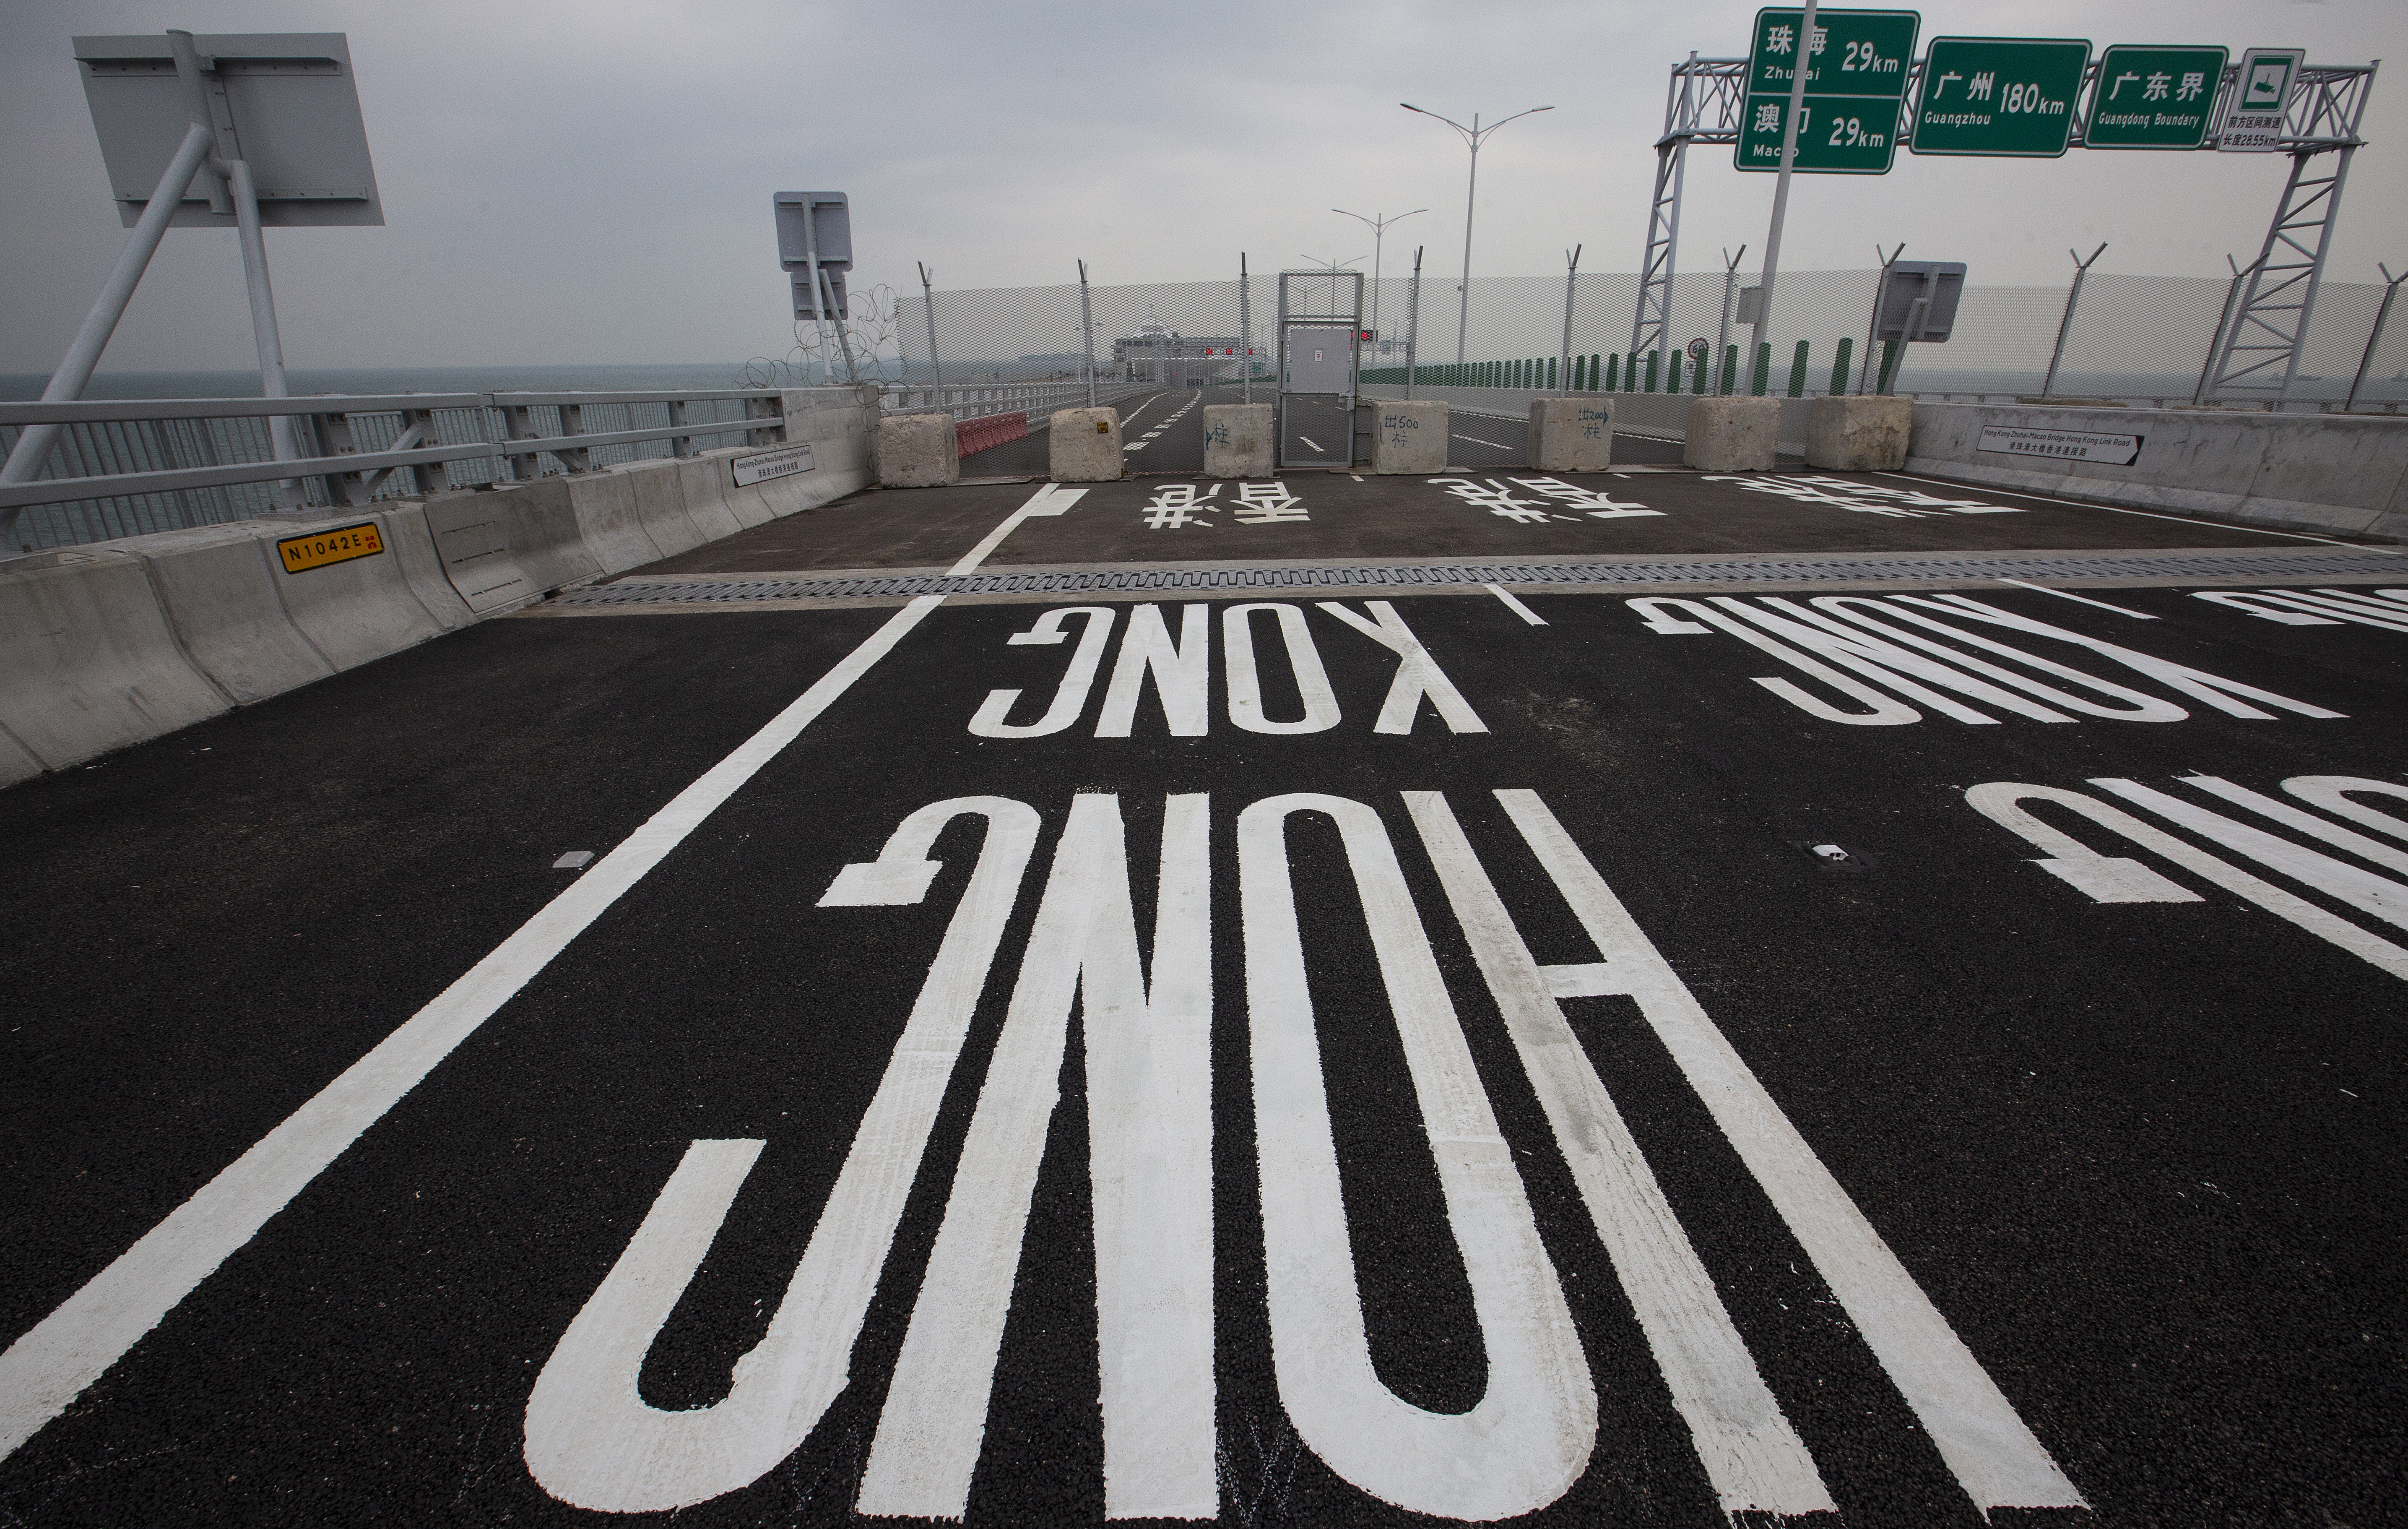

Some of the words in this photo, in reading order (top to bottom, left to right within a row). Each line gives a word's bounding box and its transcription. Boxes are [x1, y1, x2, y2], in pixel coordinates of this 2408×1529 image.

[1841, 41, 1899, 73] 29km
[1764, 65, 1820, 81] Zhuai
[2109, 70, 2205, 102] 广东界
[1933, 70, 1995, 101] 广州
[2000, 83, 2065, 115] 180km
[1828, 117, 1884, 148] 29km
[1925, 111, 1991, 128] Guangzhou
[2099, 112, 2151, 129] Guangdong
[2154, 112, 2201, 129] Boundary
[2227, 115, 2282, 128] 前方区间测速
[1753, 143, 1799, 157] Maco
[1997, 430, 2046, 440] Kong-Zhuhai-Macao
[2047, 434, 2065, 442] Bridge
[2065, 435, 2081, 444] Hong
[2082, 436, 2098, 445] Kong
[288, 534, 361, 561] N1042E
[967, 601, 1490, 737] KONG
[1625, 594, 2351, 725] KONG
[523, 789, 2091, 1523] HONG
